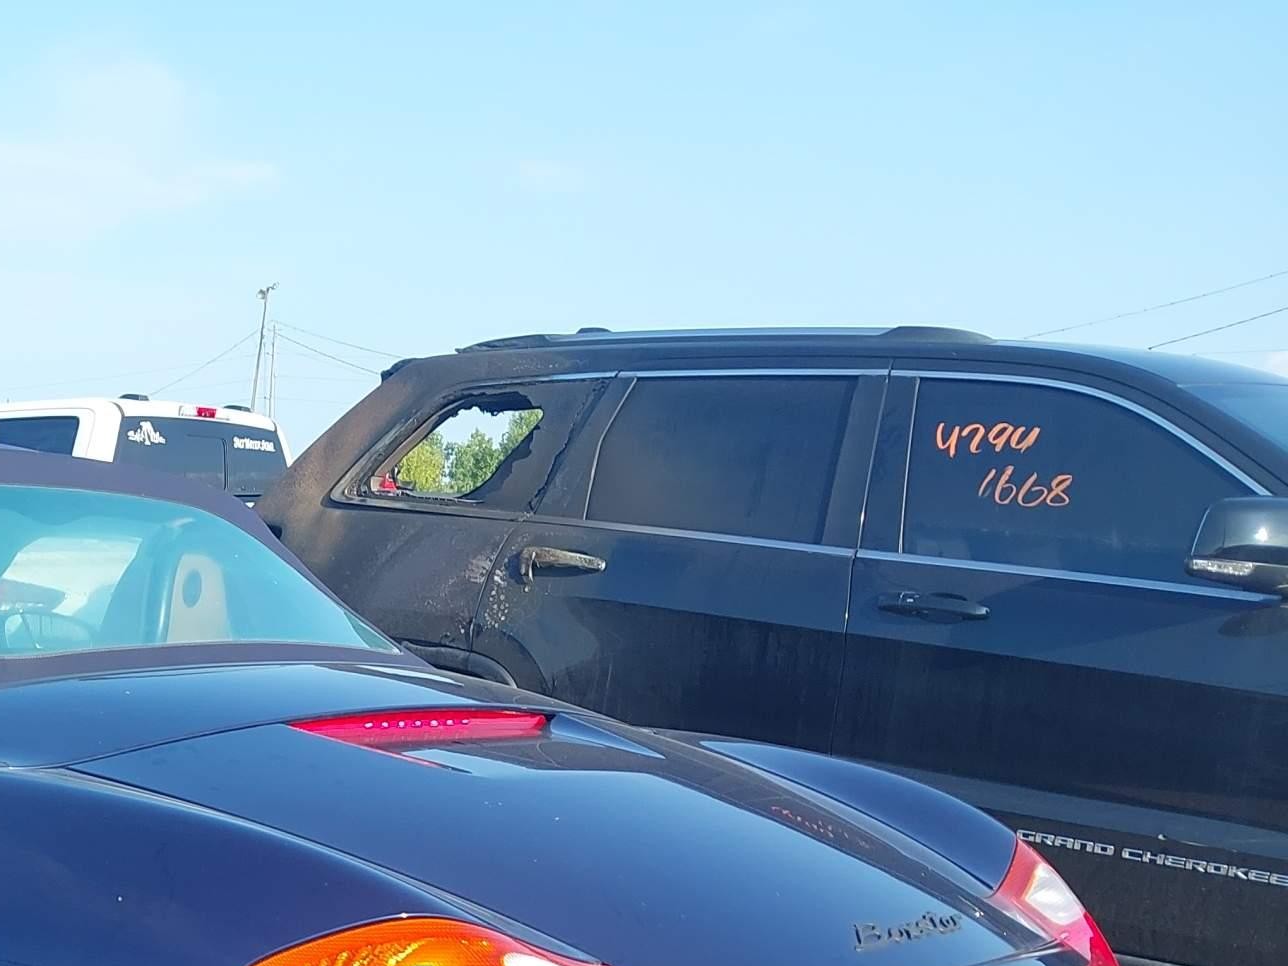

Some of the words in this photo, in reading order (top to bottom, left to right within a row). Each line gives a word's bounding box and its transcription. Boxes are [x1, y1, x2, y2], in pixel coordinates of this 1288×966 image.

[978, 465, 1073, 507] 1668
[1016, 829, 1114, 857] GRAND
[1122, 847, 1288, 887] CHEROKEE
